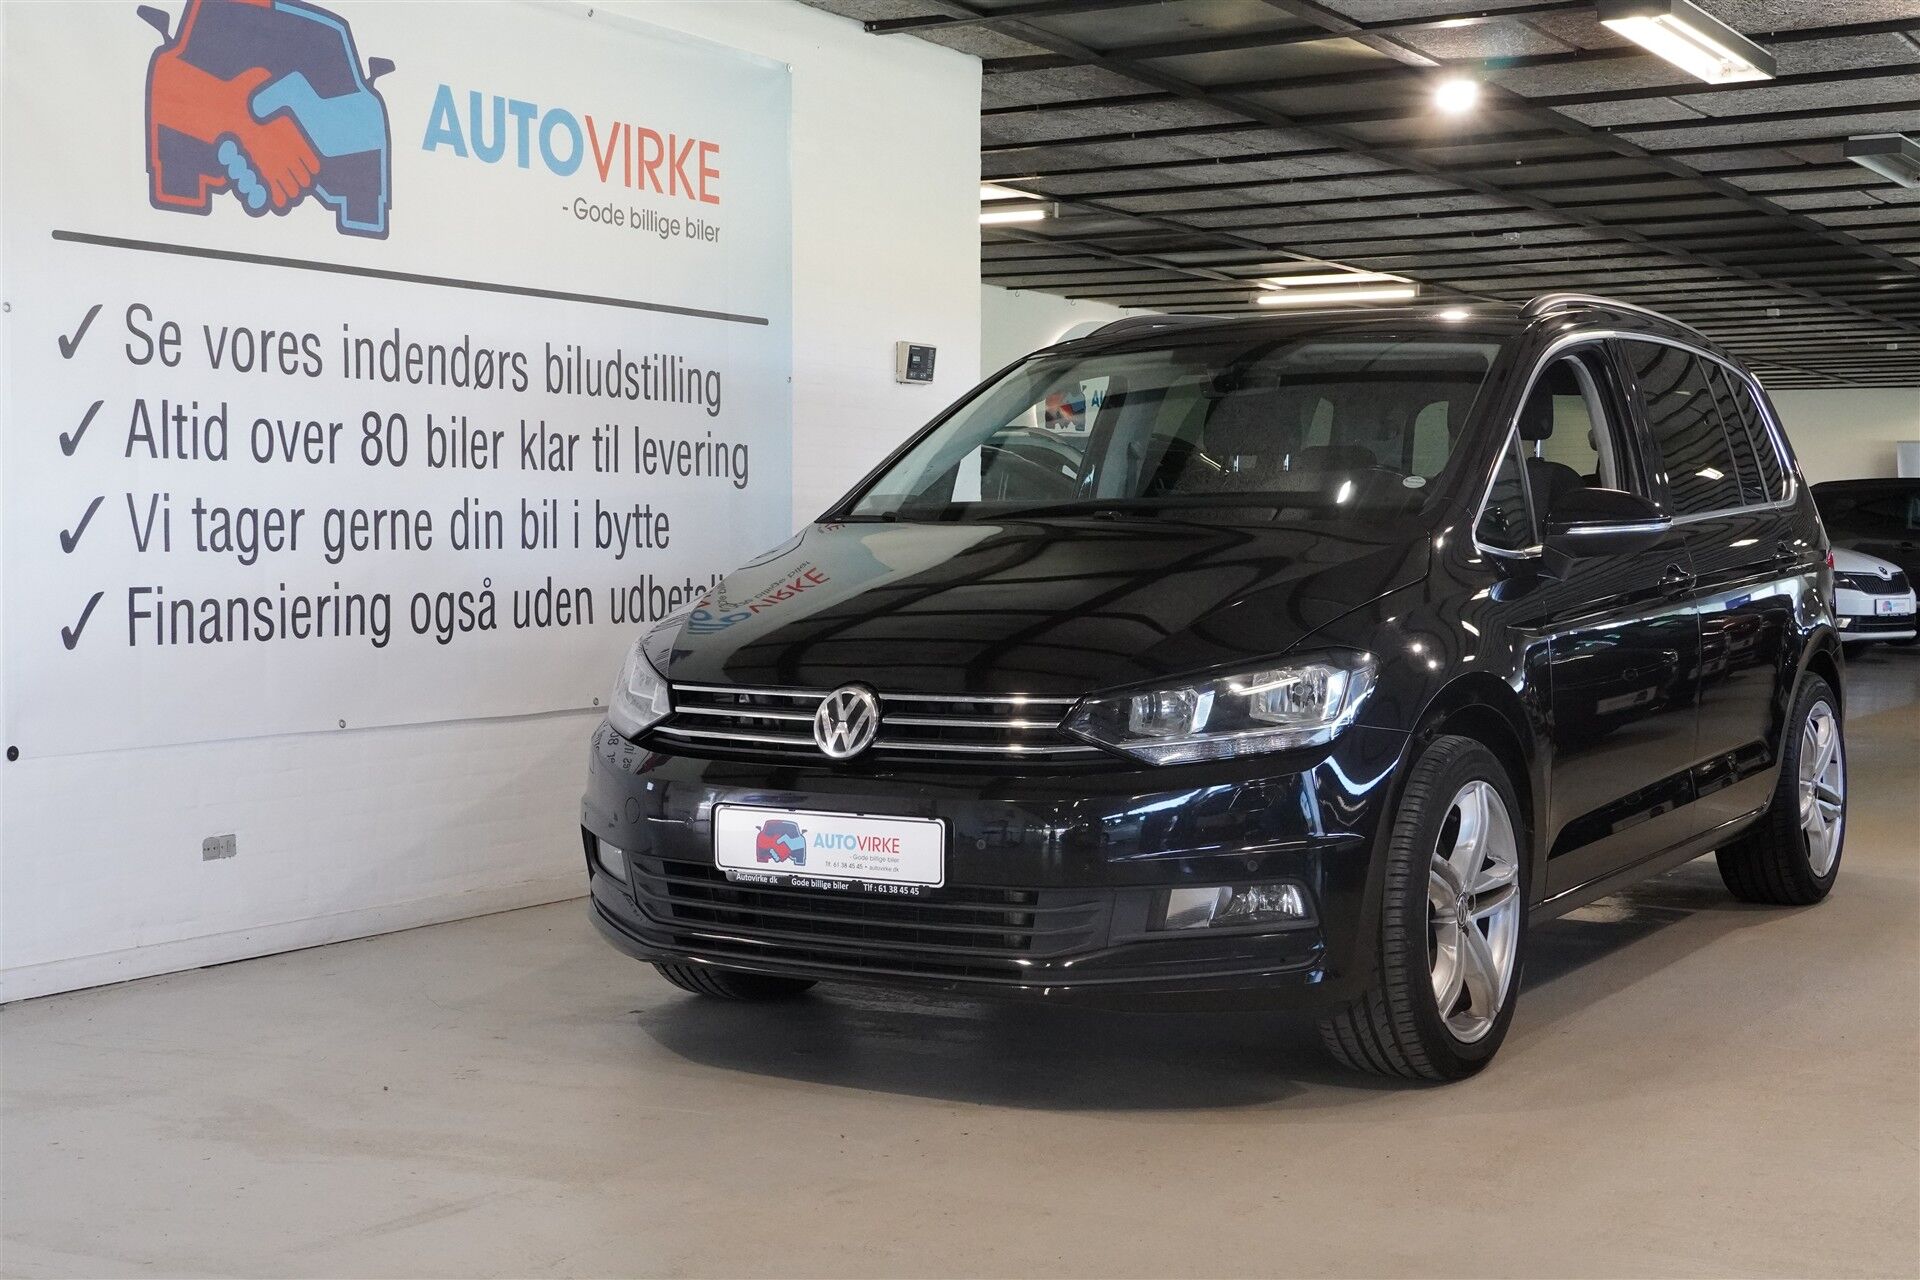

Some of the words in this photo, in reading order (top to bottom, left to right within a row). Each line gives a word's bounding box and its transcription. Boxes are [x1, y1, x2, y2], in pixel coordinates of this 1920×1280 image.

[423, 84, 721, 205] AUTOVIRKE
[574, 197, 625, 226] Gode
[630, 207, 681, 240] billige
[685, 217, 721, 243] biler
[125, 302, 182, 368] Se
[203, 325, 323, 378] vores
[343, 322, 529, 393] indendørs
[545, 341, 722, 416] biludstilling
[124, 399, 228, 462] Altid
[250, 412, 344, 465] over
[360, 410, 409, 468] 80
[426, 413, 505, 471] biler
[520, 419, 579, 473] klar
[591, 424, 620, 474] til
[634, 425, 749, 490] levering
[126, 492, 171, 553] Vi
[191, 497, 306, 567] tager
[323, 507, 433, 565] gerne
[450, 496, 503, 551] din
[520, 497, 558, 551] bil
[573, 498, 579, 550] i
[595, 498, 670, 561] bytte
[128, 582, 391, 649] Finansiering
[410, 575, 498, 635] også
[513, 575, 594, 631] uden
[813, 833, 900, 854] AUTOVIRKE
[852, 854, 870, 862] Gode
[869, 855, 887, 864] billige
[791, 877, 810, 887] Gode
[810, 879, 832, 890] billige
[832, 881, 850, 890] biler
[878, 884, 888, 893] 61
[888, 885, 898, 894] 38
[899, 886, 909, 895] 45
[909, 887, 920, 896] 45
